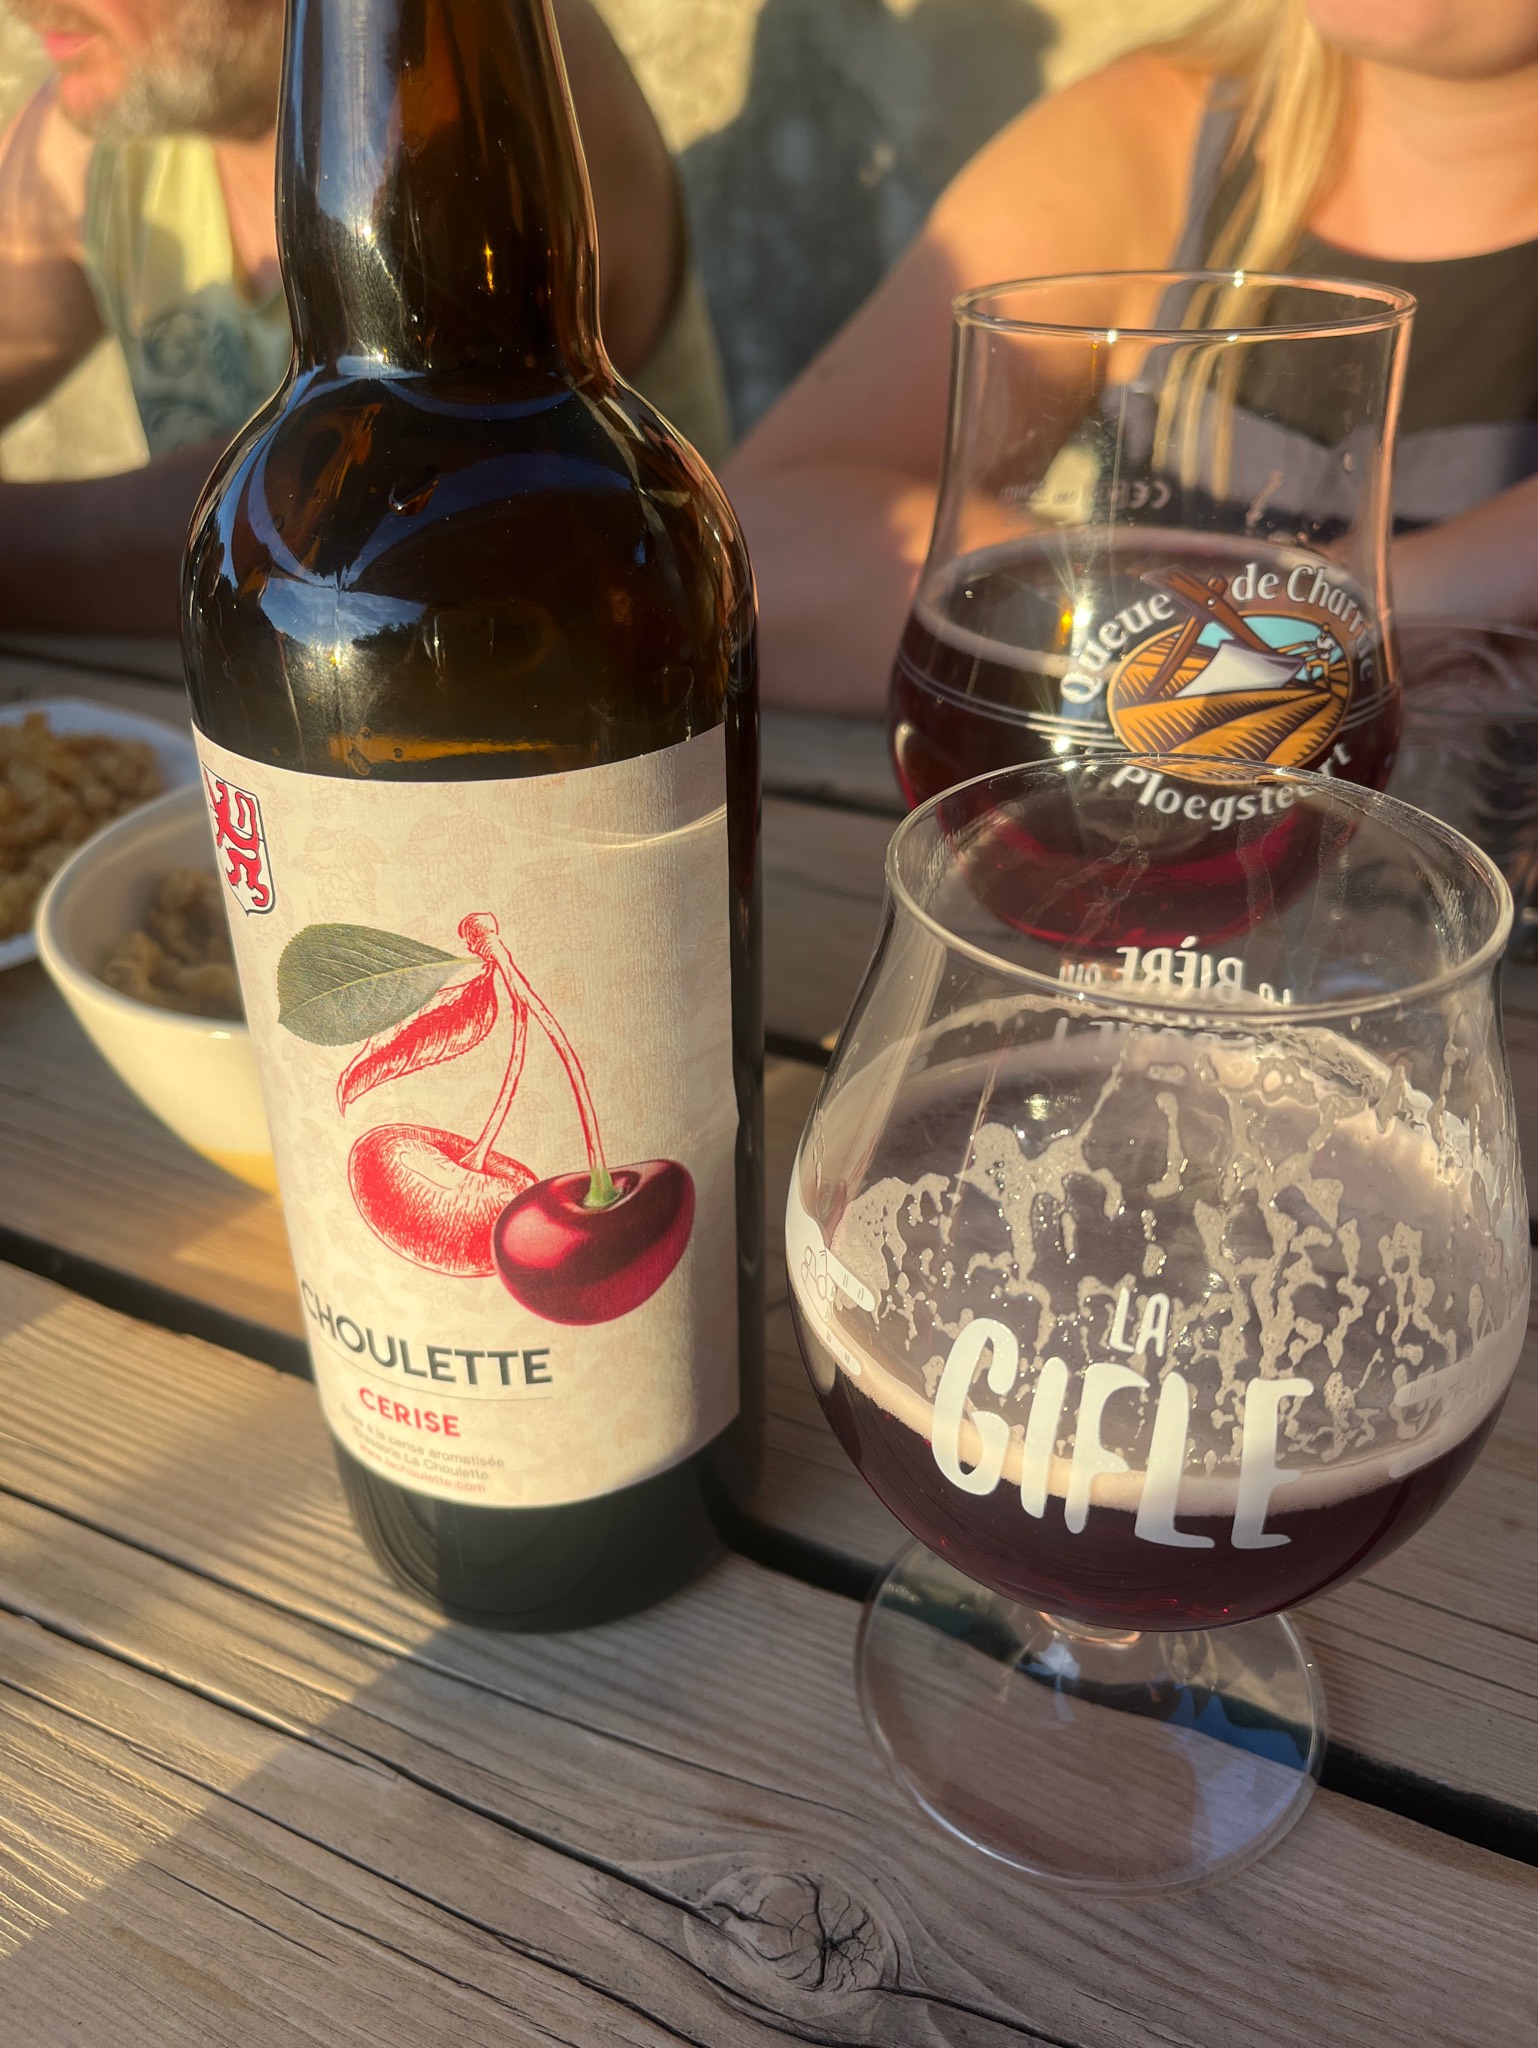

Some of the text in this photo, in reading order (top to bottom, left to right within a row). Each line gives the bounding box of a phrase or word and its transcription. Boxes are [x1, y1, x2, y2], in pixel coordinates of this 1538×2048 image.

[1060, 592, 1176, 704] Queue
[1230, 563, 1279, 601] de
[300, 1279, 554, 1386] CHOULETTE
[1109, 1286, 1171, 1358] LA
[358, 1386, 462, 1437] CERISE
[931, 1317, 1315, 1550] GIFLE
[423, 1458, 489, 1481] Choulette
[429, 1447, 505, 1468] aromatisée
